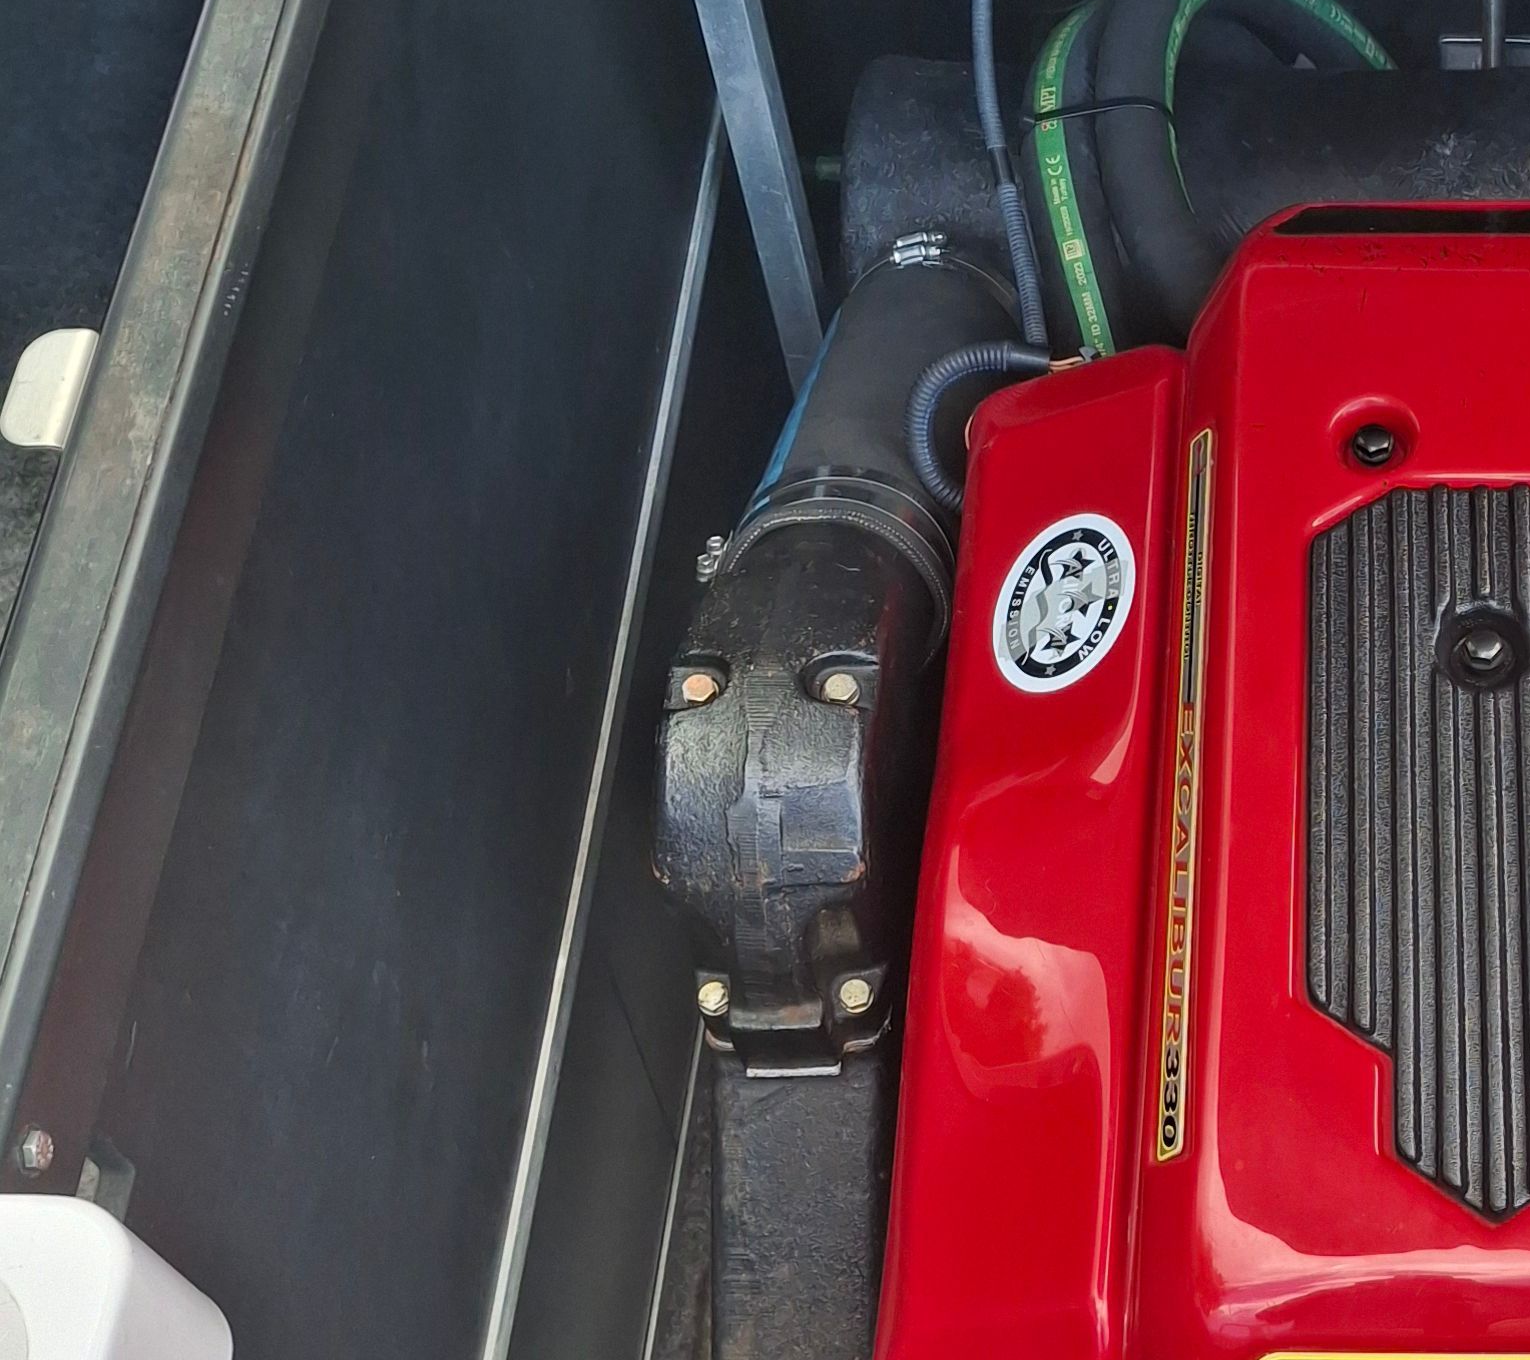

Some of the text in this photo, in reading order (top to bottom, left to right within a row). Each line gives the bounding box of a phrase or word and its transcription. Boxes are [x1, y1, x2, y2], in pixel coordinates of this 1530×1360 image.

[1091, 324, 1101, 335] ID
[1009, 565, 1035, 650] EMISSION
[1078, 538, 1119, 660] ULTRA LOW
[1161, 704, 1195, 1148] EXCALIBUR 330
